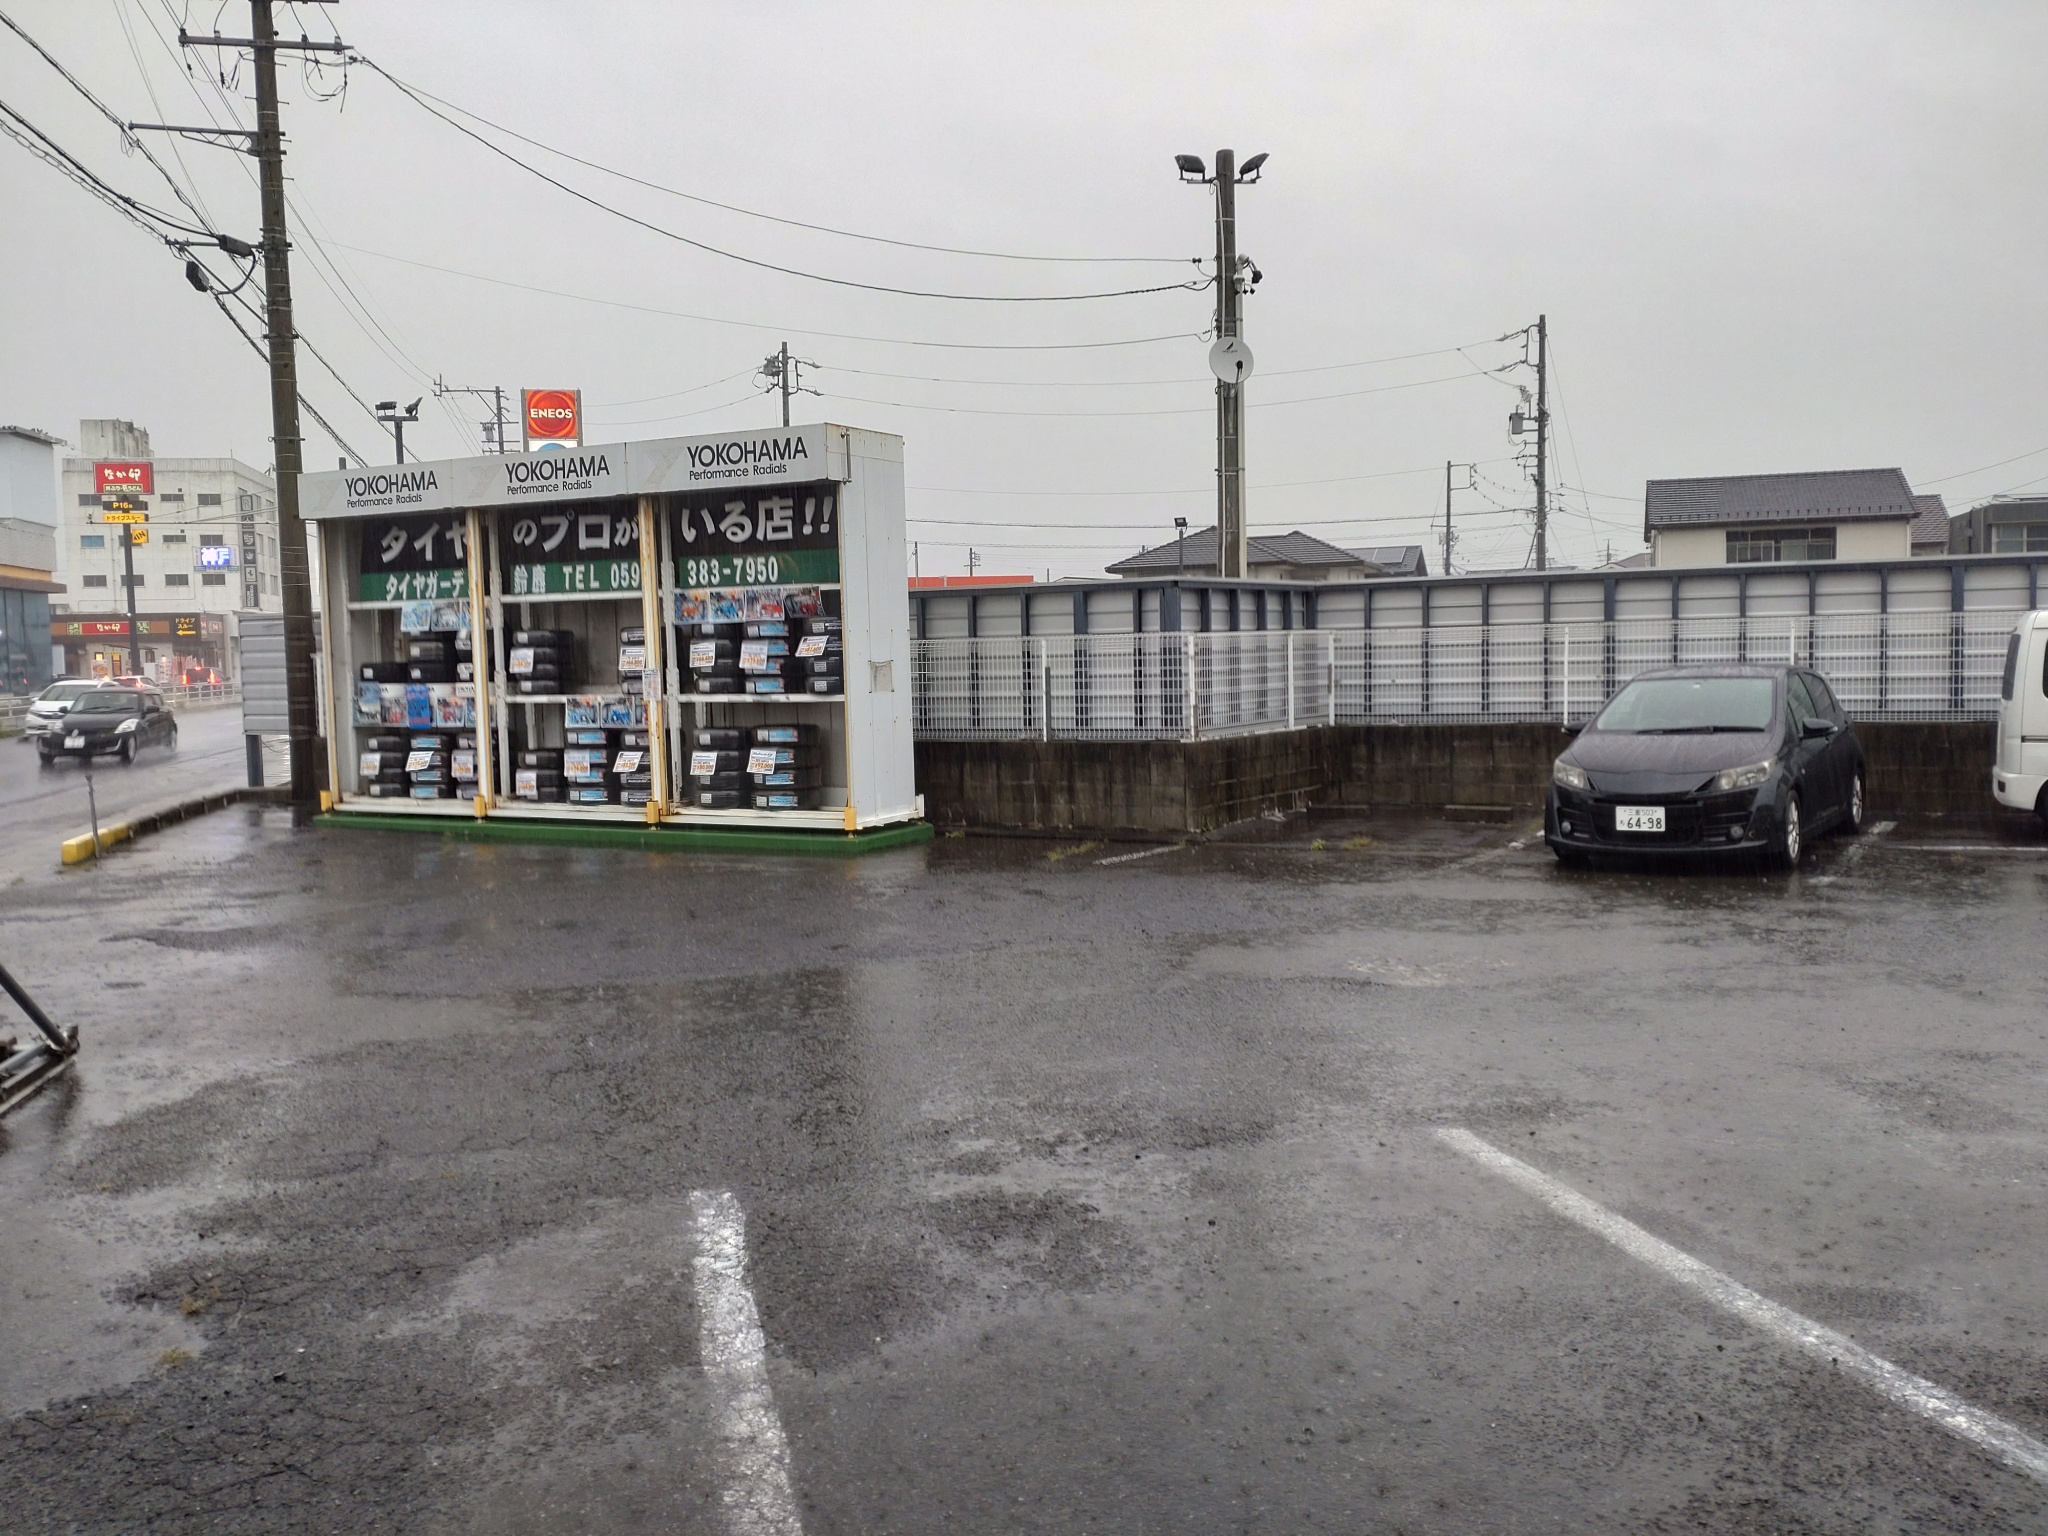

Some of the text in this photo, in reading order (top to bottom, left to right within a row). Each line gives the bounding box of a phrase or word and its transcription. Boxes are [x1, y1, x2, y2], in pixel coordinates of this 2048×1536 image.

[530, 408, 573, 419] ENEOS
[683, 436, 808, 468] YOKOHAMA
[104, 468, 141, 482] なか卯
[505, 454, 610, 484] YOKOHAMA
[689, 463, 787, 481] Performance Radials
[345, 470, 438, 497] YOKOHAMA
[507, 479, 593, 496] Performance Radials
[347, 493, 423, 508] Performance Radials
[381, 495, 833, 564] タイヤ のプロが いる店!!
[385, 569, 470, 602] タイヤガーデ
[563, 563, 600, 591] TEL
[611, 561, 640, 589] 059
[687, 555, 779, 586] 383-7950
[1627, 817, 1663, 829] 64-98
